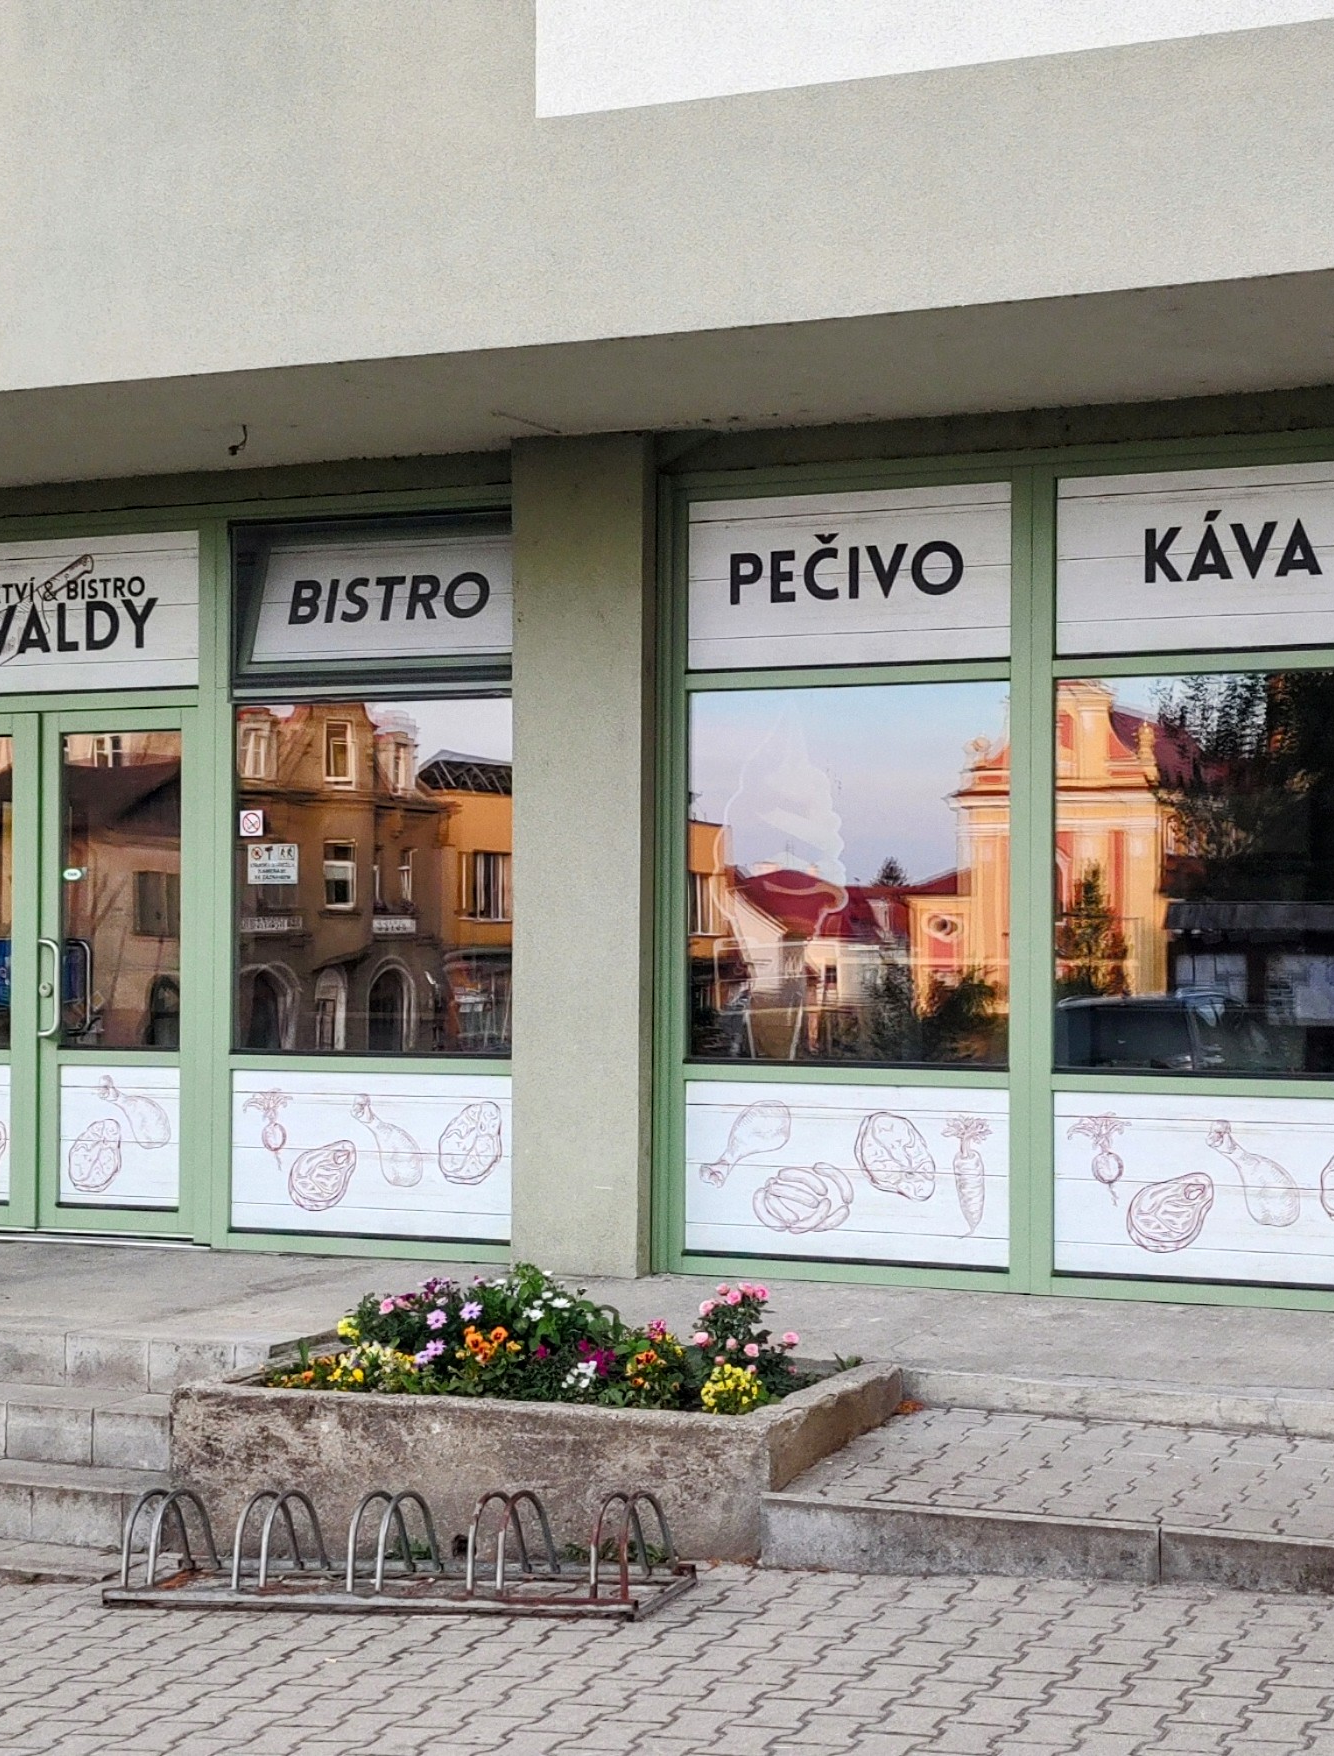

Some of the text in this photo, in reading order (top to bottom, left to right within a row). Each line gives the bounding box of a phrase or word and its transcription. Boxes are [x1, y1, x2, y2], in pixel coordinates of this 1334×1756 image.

[729, 533, 964, 605] PEČIVO
[1143, 509, 1323, 583] KÁVA
[43, 581, 58, 601] &
[67, 576, 145, 600] BISTRO
[288, 571, 490, 625] BISTRO
